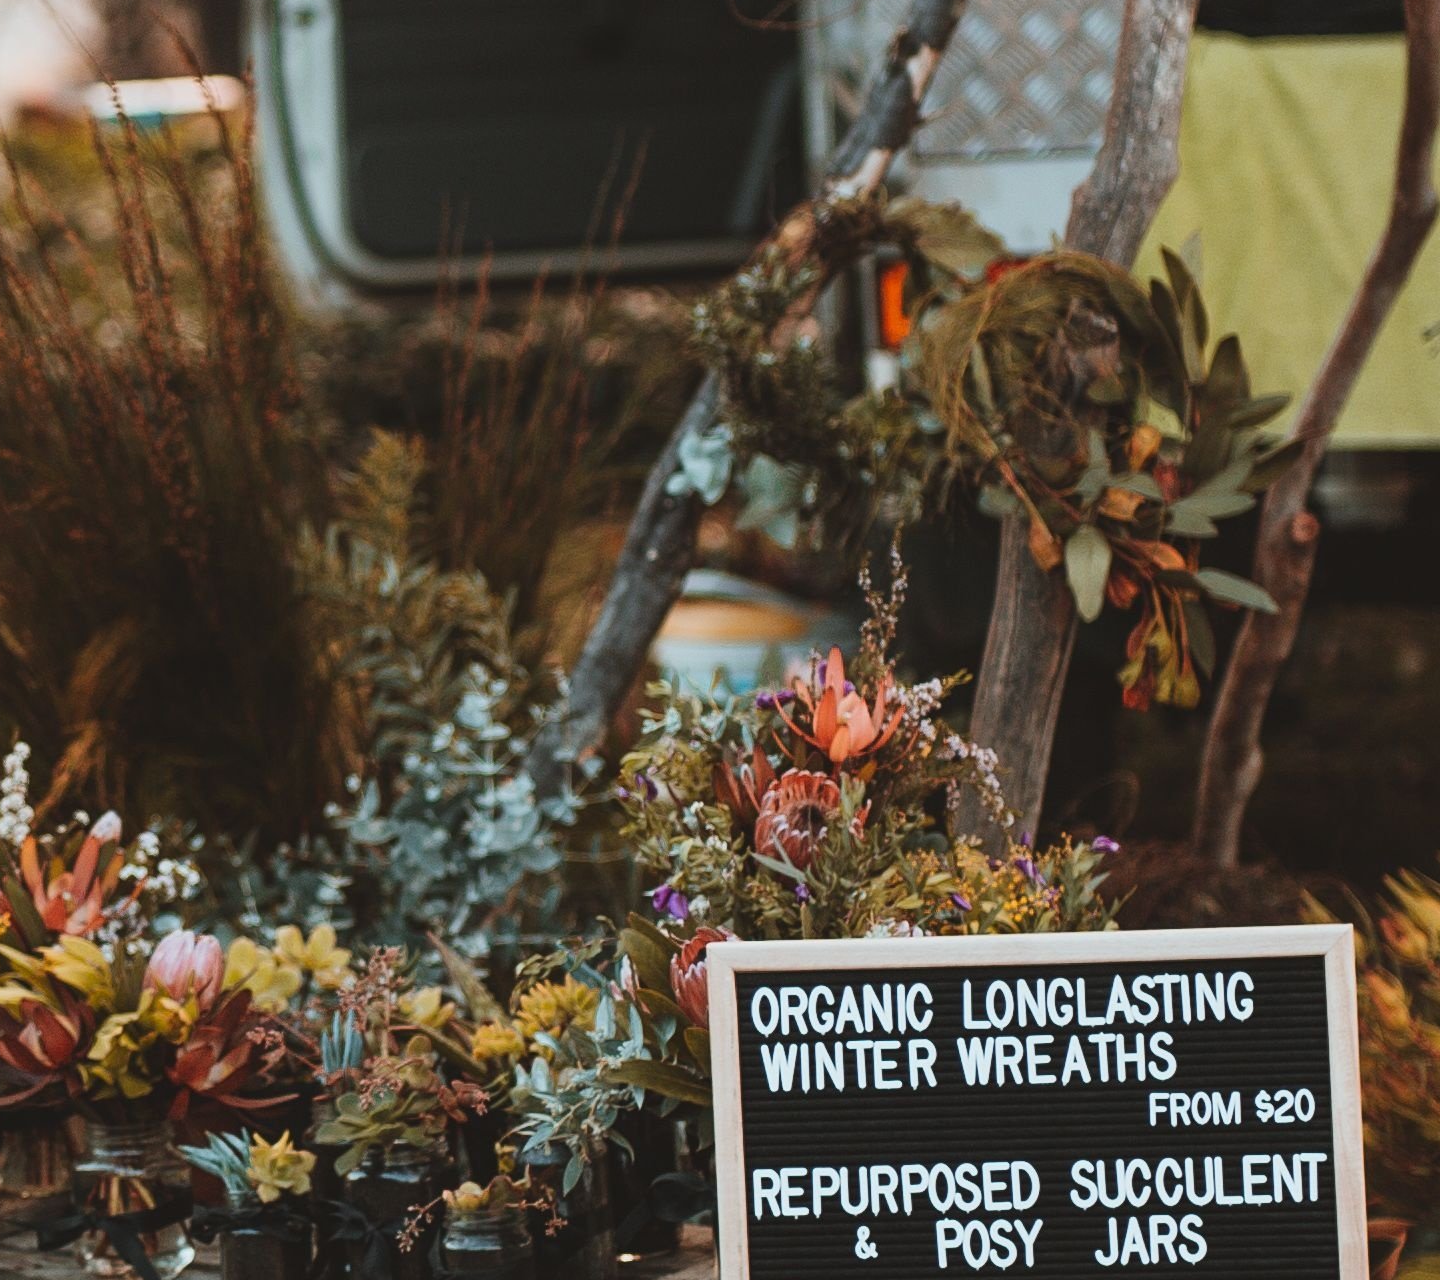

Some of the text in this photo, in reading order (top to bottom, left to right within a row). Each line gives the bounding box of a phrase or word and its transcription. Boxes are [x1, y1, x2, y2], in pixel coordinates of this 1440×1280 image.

[750, 970, 1256, 1039] ORGANIC LONGLASTING
[759, 1030, 1178, 1095] WINTER WREATHS
[1148, 1087, 1317, 1129] FROM $20
[751, 1151, 1329, 1222] REPURPOSED SUCCULENT
[853, 1212, 1209, 1272] & POSY JARS
